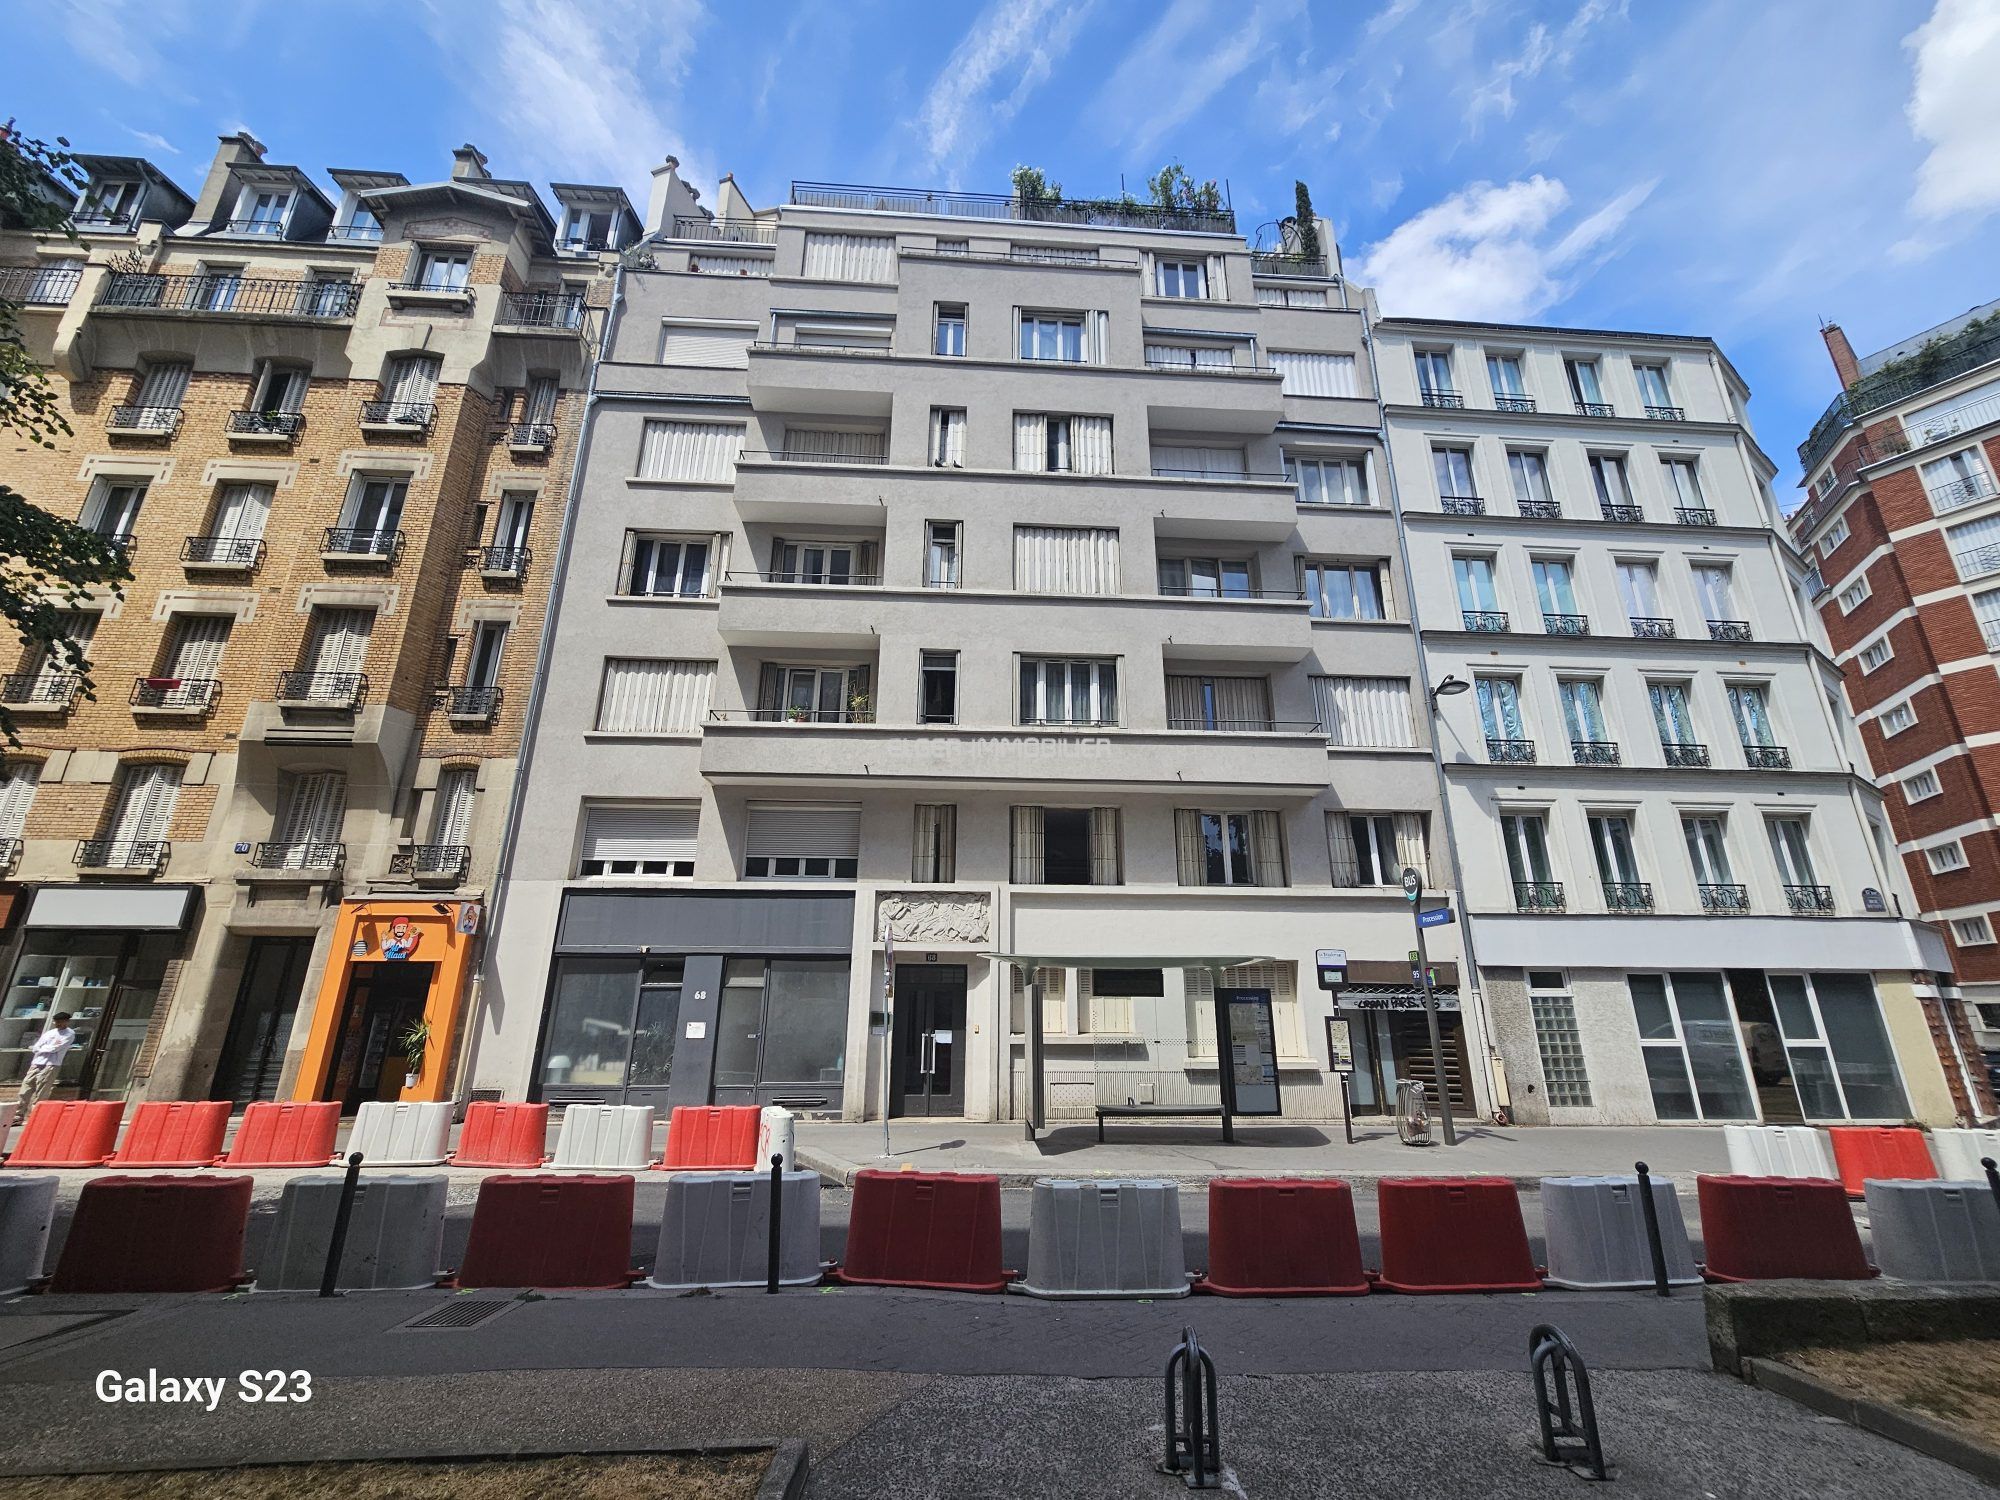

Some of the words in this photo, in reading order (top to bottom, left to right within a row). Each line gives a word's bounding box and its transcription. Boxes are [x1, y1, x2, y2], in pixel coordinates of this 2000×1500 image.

[236, 843, 249, 852] 70
[1404, 874, 1416, 887] BUS
[1422, 914, 1444, 923] Procession
[1412, 970, 1420, 979] 95
[694, 990, 707, 1000] 68
